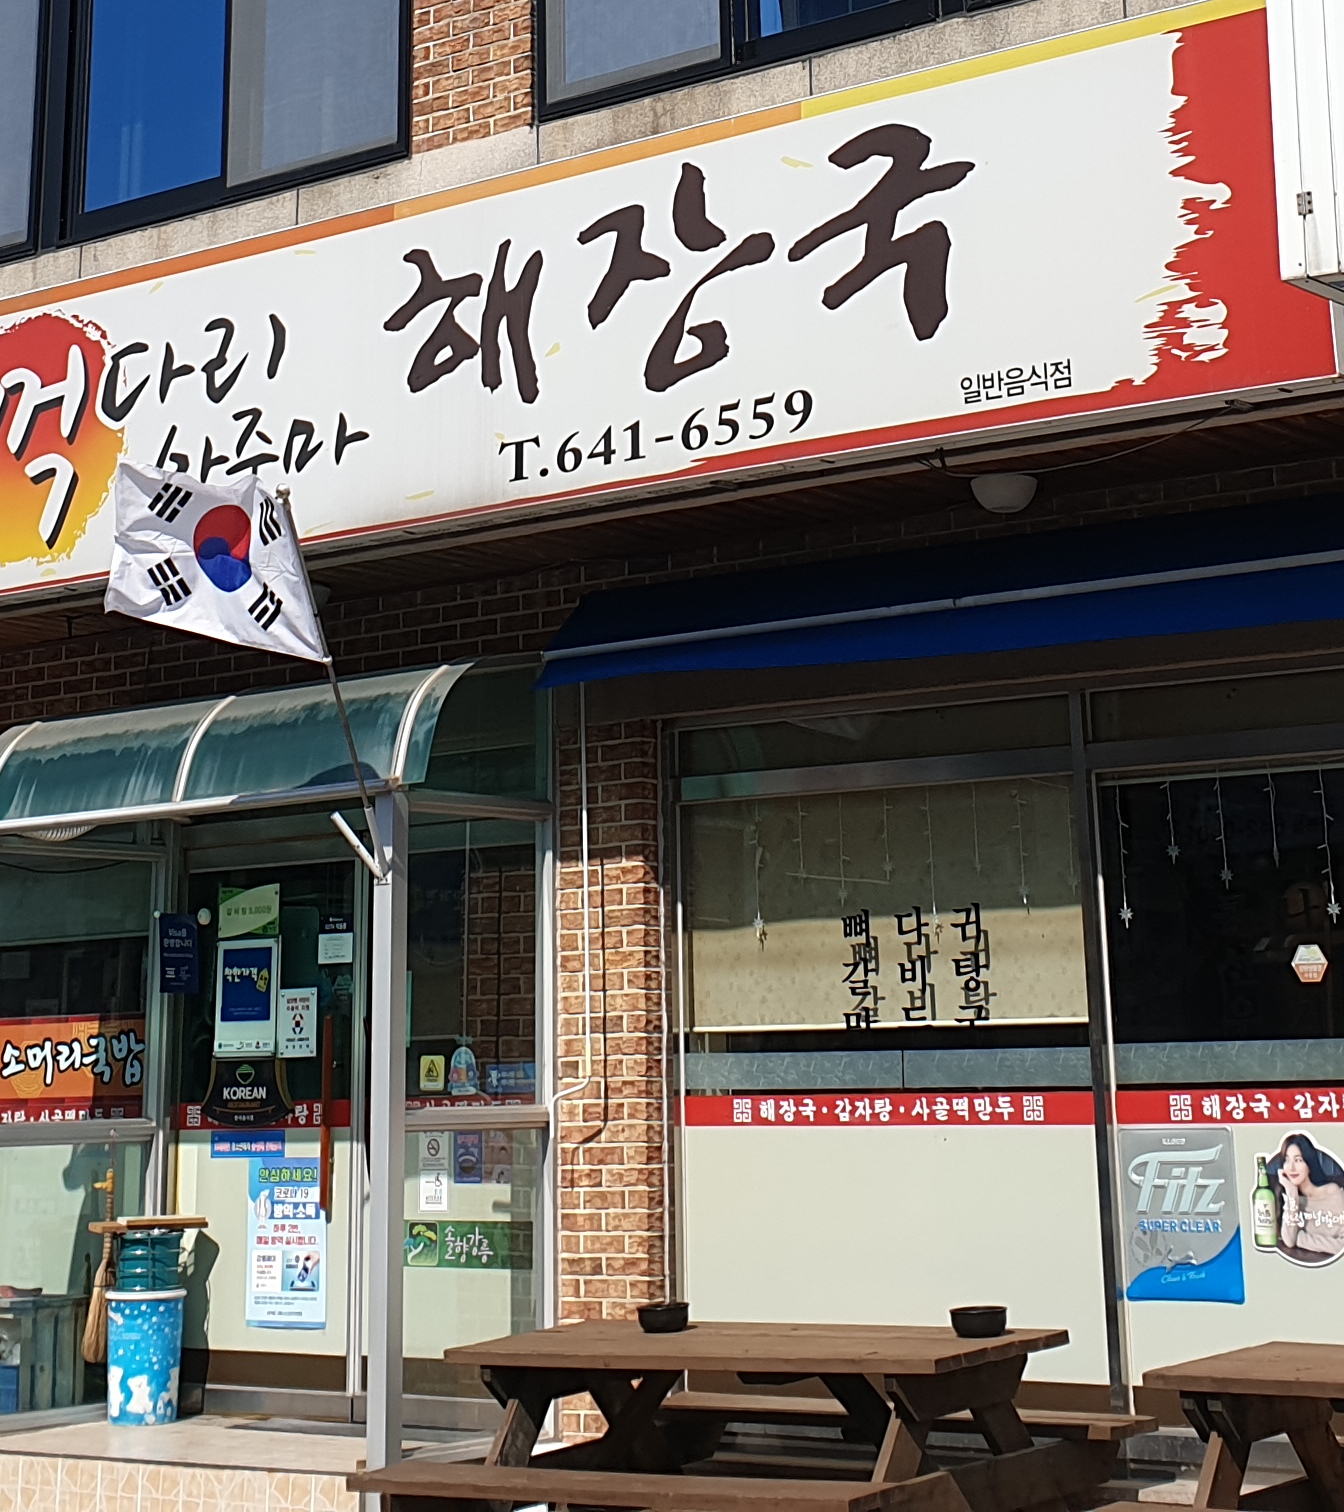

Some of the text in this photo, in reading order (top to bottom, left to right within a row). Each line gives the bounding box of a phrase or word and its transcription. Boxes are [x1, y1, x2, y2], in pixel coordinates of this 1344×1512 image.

[384, 123, 976, 402] 해장국
[960, 360, 1074, 405] 일반음식점
[500, 389, 814, 482] T.641-6559
[841, 902, 981, 948] 뼈다귀
[842, 952, 989, 996] 갈비탕
[3, 1031, 146, 1086] 소머리국밥
[223, 1086, 267, 1100] KOREAN
[759, 1096, 1014, 1122] 해장국 감자탕 사골떡만두
[1202, 1094, 1270, 1119] 해장국
[259, 1167, 318, 1183] 안심하세요!
[1128, 1143, 1226, 1215] Fitz
[444, 1225, 494, 1263] 솔향강릉
[1139, 1219, 1223, 1233] SUPER CLEAR
